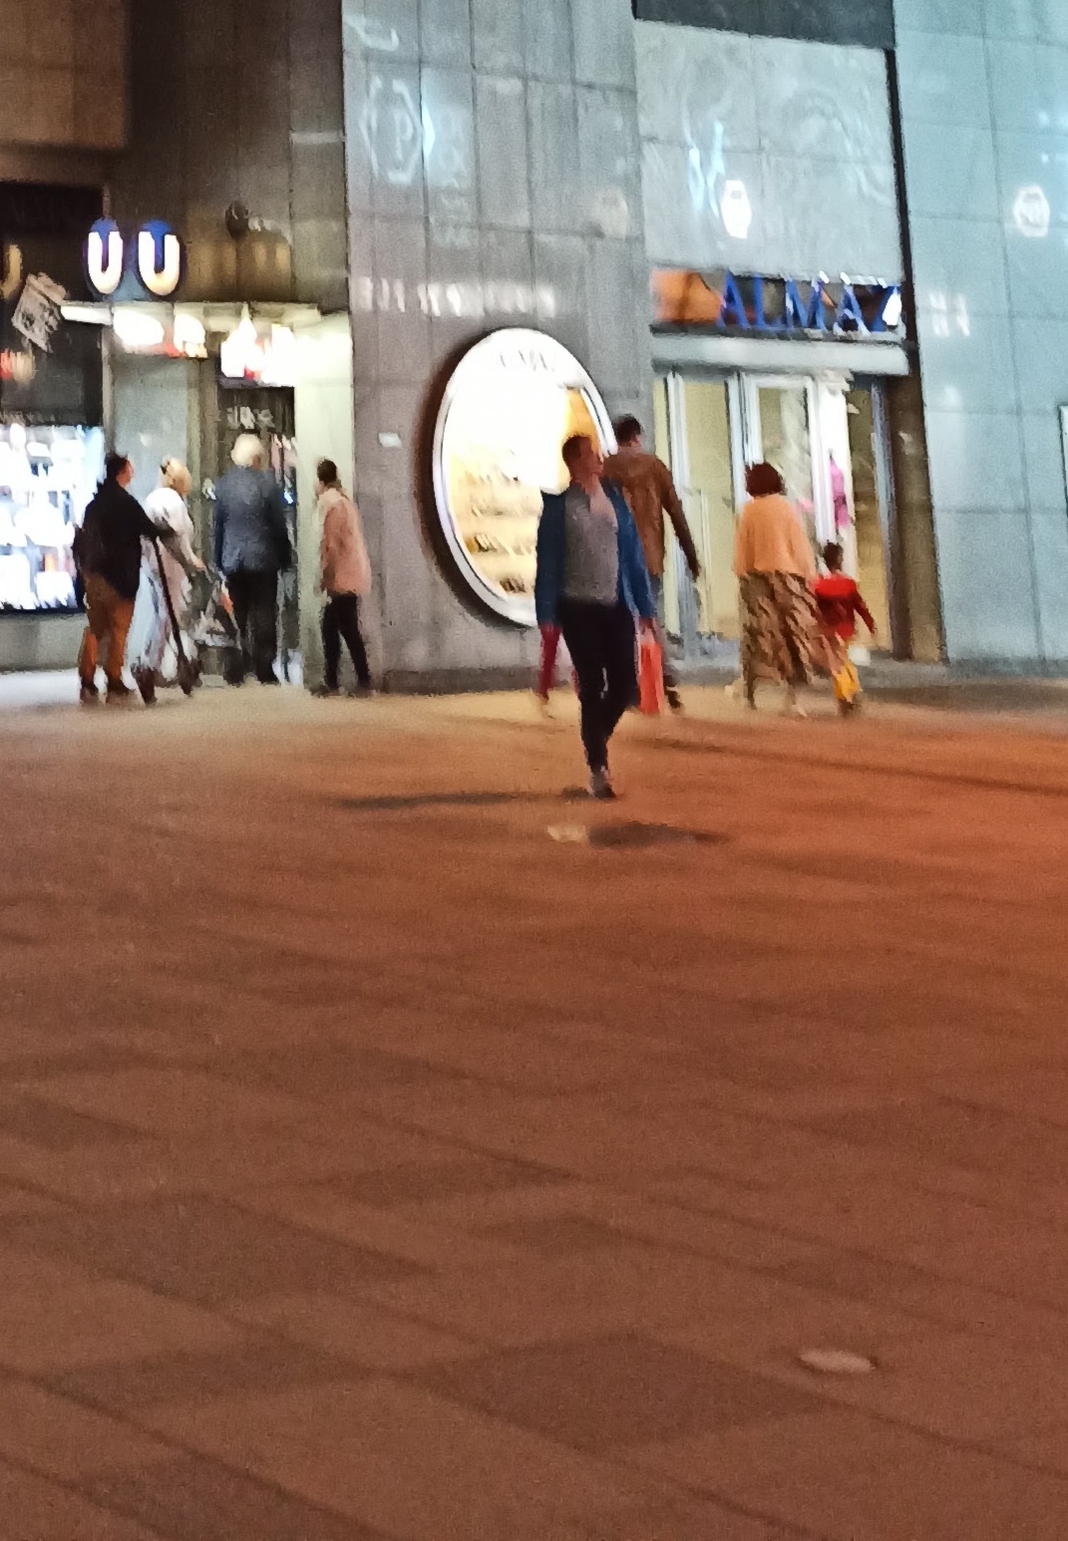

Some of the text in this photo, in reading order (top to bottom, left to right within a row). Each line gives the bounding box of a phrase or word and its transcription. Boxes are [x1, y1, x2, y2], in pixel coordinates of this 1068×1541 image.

[87, 231, 181, 296] U U
[717, 265, 903, 336] ALMAZ
